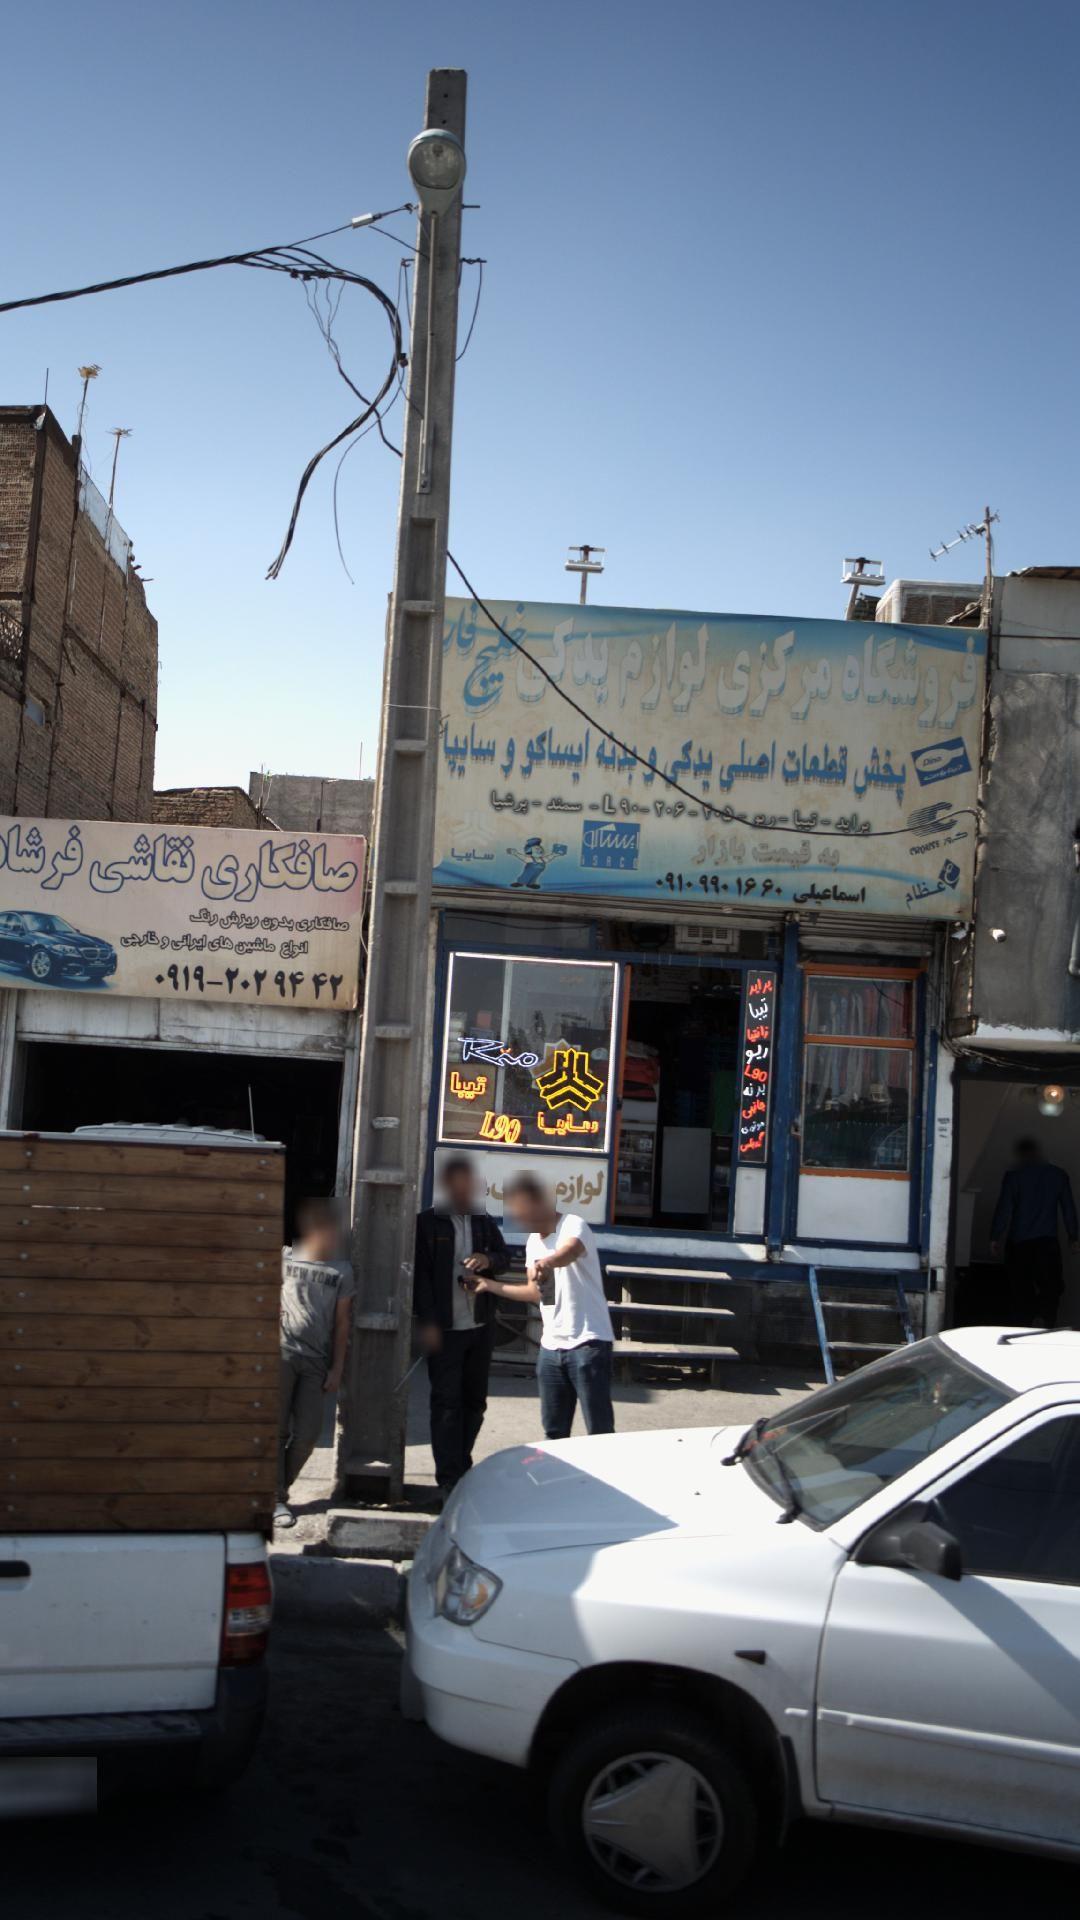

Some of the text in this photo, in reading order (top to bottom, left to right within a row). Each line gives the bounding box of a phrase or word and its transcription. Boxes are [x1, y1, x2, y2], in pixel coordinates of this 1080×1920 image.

[516, 617, 977, 729] فروشگاه مرکزی لوازم یدکی
[444, 720, 906, 806] پخش قطعات اصلی یدکی و بدنه ایساکو و سایپا
[490, 789, 529, 814] پرشیا
[547, 796, 584, 812] سمند
[654, 801, 685, 818] ۲۰۶
[793, 809, 818, 830] تیبا
[835, 814, 871, 833] براید
[0, 824, 358, 902] صافکاری نقاشی فرشا
[451, 847, 496, 862] سایپا
[793, 884, 866, 905] اسماعیلی
[905, 881, 946, 910] عظام
[190, 908, 350, 932] صافکاری بدون ریزش رنگ
[120, 931, 309, 959] انواع ماشین های ایرانی و خارجی
[748, 997, 769, 1021] تیبا
[458, 1038, 540, 1067] Rio
[745, 1044, 769, 1064] ریو
[743, 1064, 768, 1082] L90
[450, 1072, 487, 1099] تیبا
[479, 1111, 521, 1144] L90
[537, 1112, 599, 1135] سایپا
[286, 1264, 339, 1287] NEW YORK
